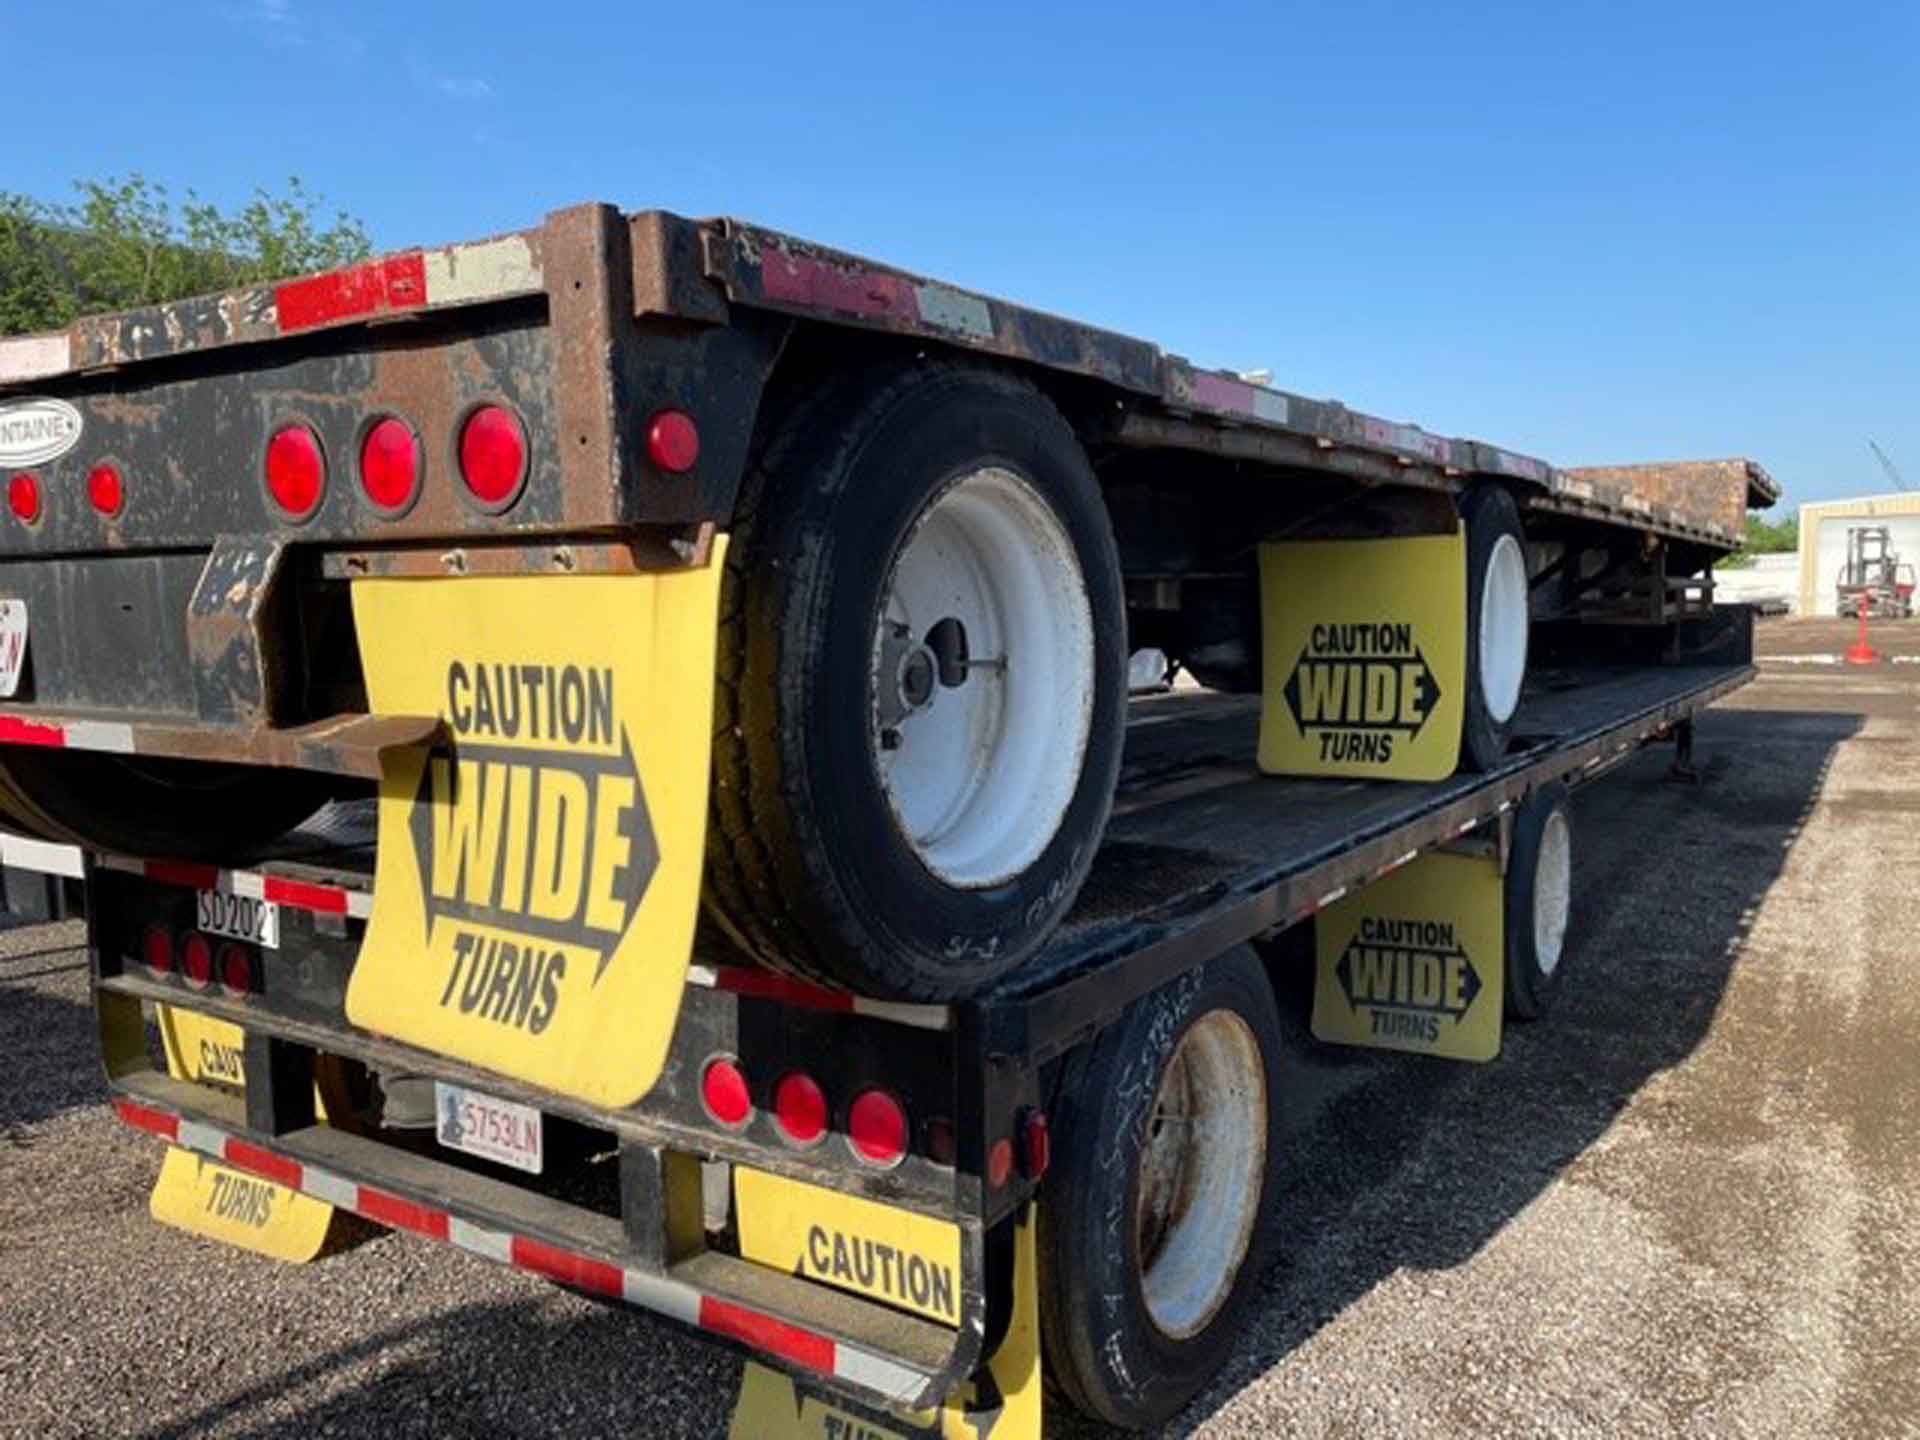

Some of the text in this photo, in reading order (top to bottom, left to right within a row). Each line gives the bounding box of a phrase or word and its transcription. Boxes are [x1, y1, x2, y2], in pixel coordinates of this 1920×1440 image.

[1311, 624, 1411, 655] CAUTION
[447, 660, 613, 746] CAUTION
[1299, 662, 1425, 725] WIDE
[1319, 731, 1394, 763] TURNS
[429, 757, 635, 934] WIDE
[1361, 917, 1454, 946] CAUTION
[440, 931, 566, 1036] TURNS
[1350, 947, 1467, 1010] WIDE
[1371, 1009, 1440, 1043] TURNS
[464, 1102, 537, 1155] 5753LN
[206, 1171, 275, 1229] TURNS
[808, 1224, 954, 1318] CAUTION
